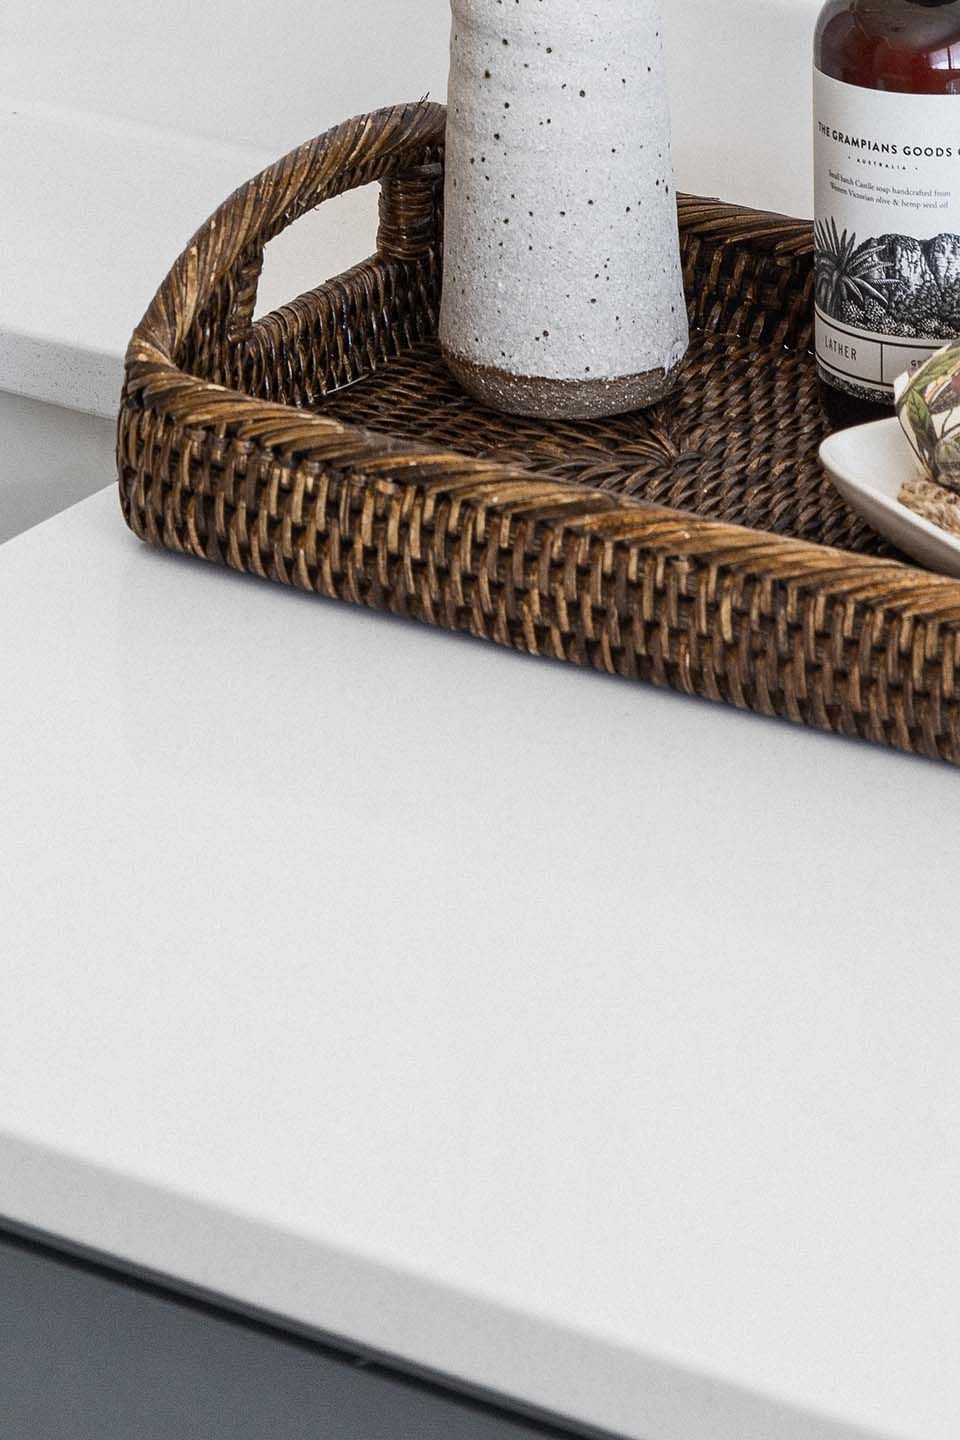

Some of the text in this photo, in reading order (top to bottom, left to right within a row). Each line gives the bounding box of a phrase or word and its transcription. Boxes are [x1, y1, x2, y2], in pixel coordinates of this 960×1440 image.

[818, 121, 830, 137] THE
[832, 130, 898, 155] GRAMPIANS
[903, 146, 952, 157] GOODS
[848, 189, 875, 203] Victorian
[875, 196, 890, 205] olive
[893, 199, 898, 207] &
[901, 199, 921, 210] hemp
[923, 201, 938, 209] seed
[939, 201, 949, 209] oil
[876, 186, 890, 195] soap
[892, 186, 933, 197] handcrafted
[934, 189, 951, 197] from
[824, 335, 857, 361] LATHER
